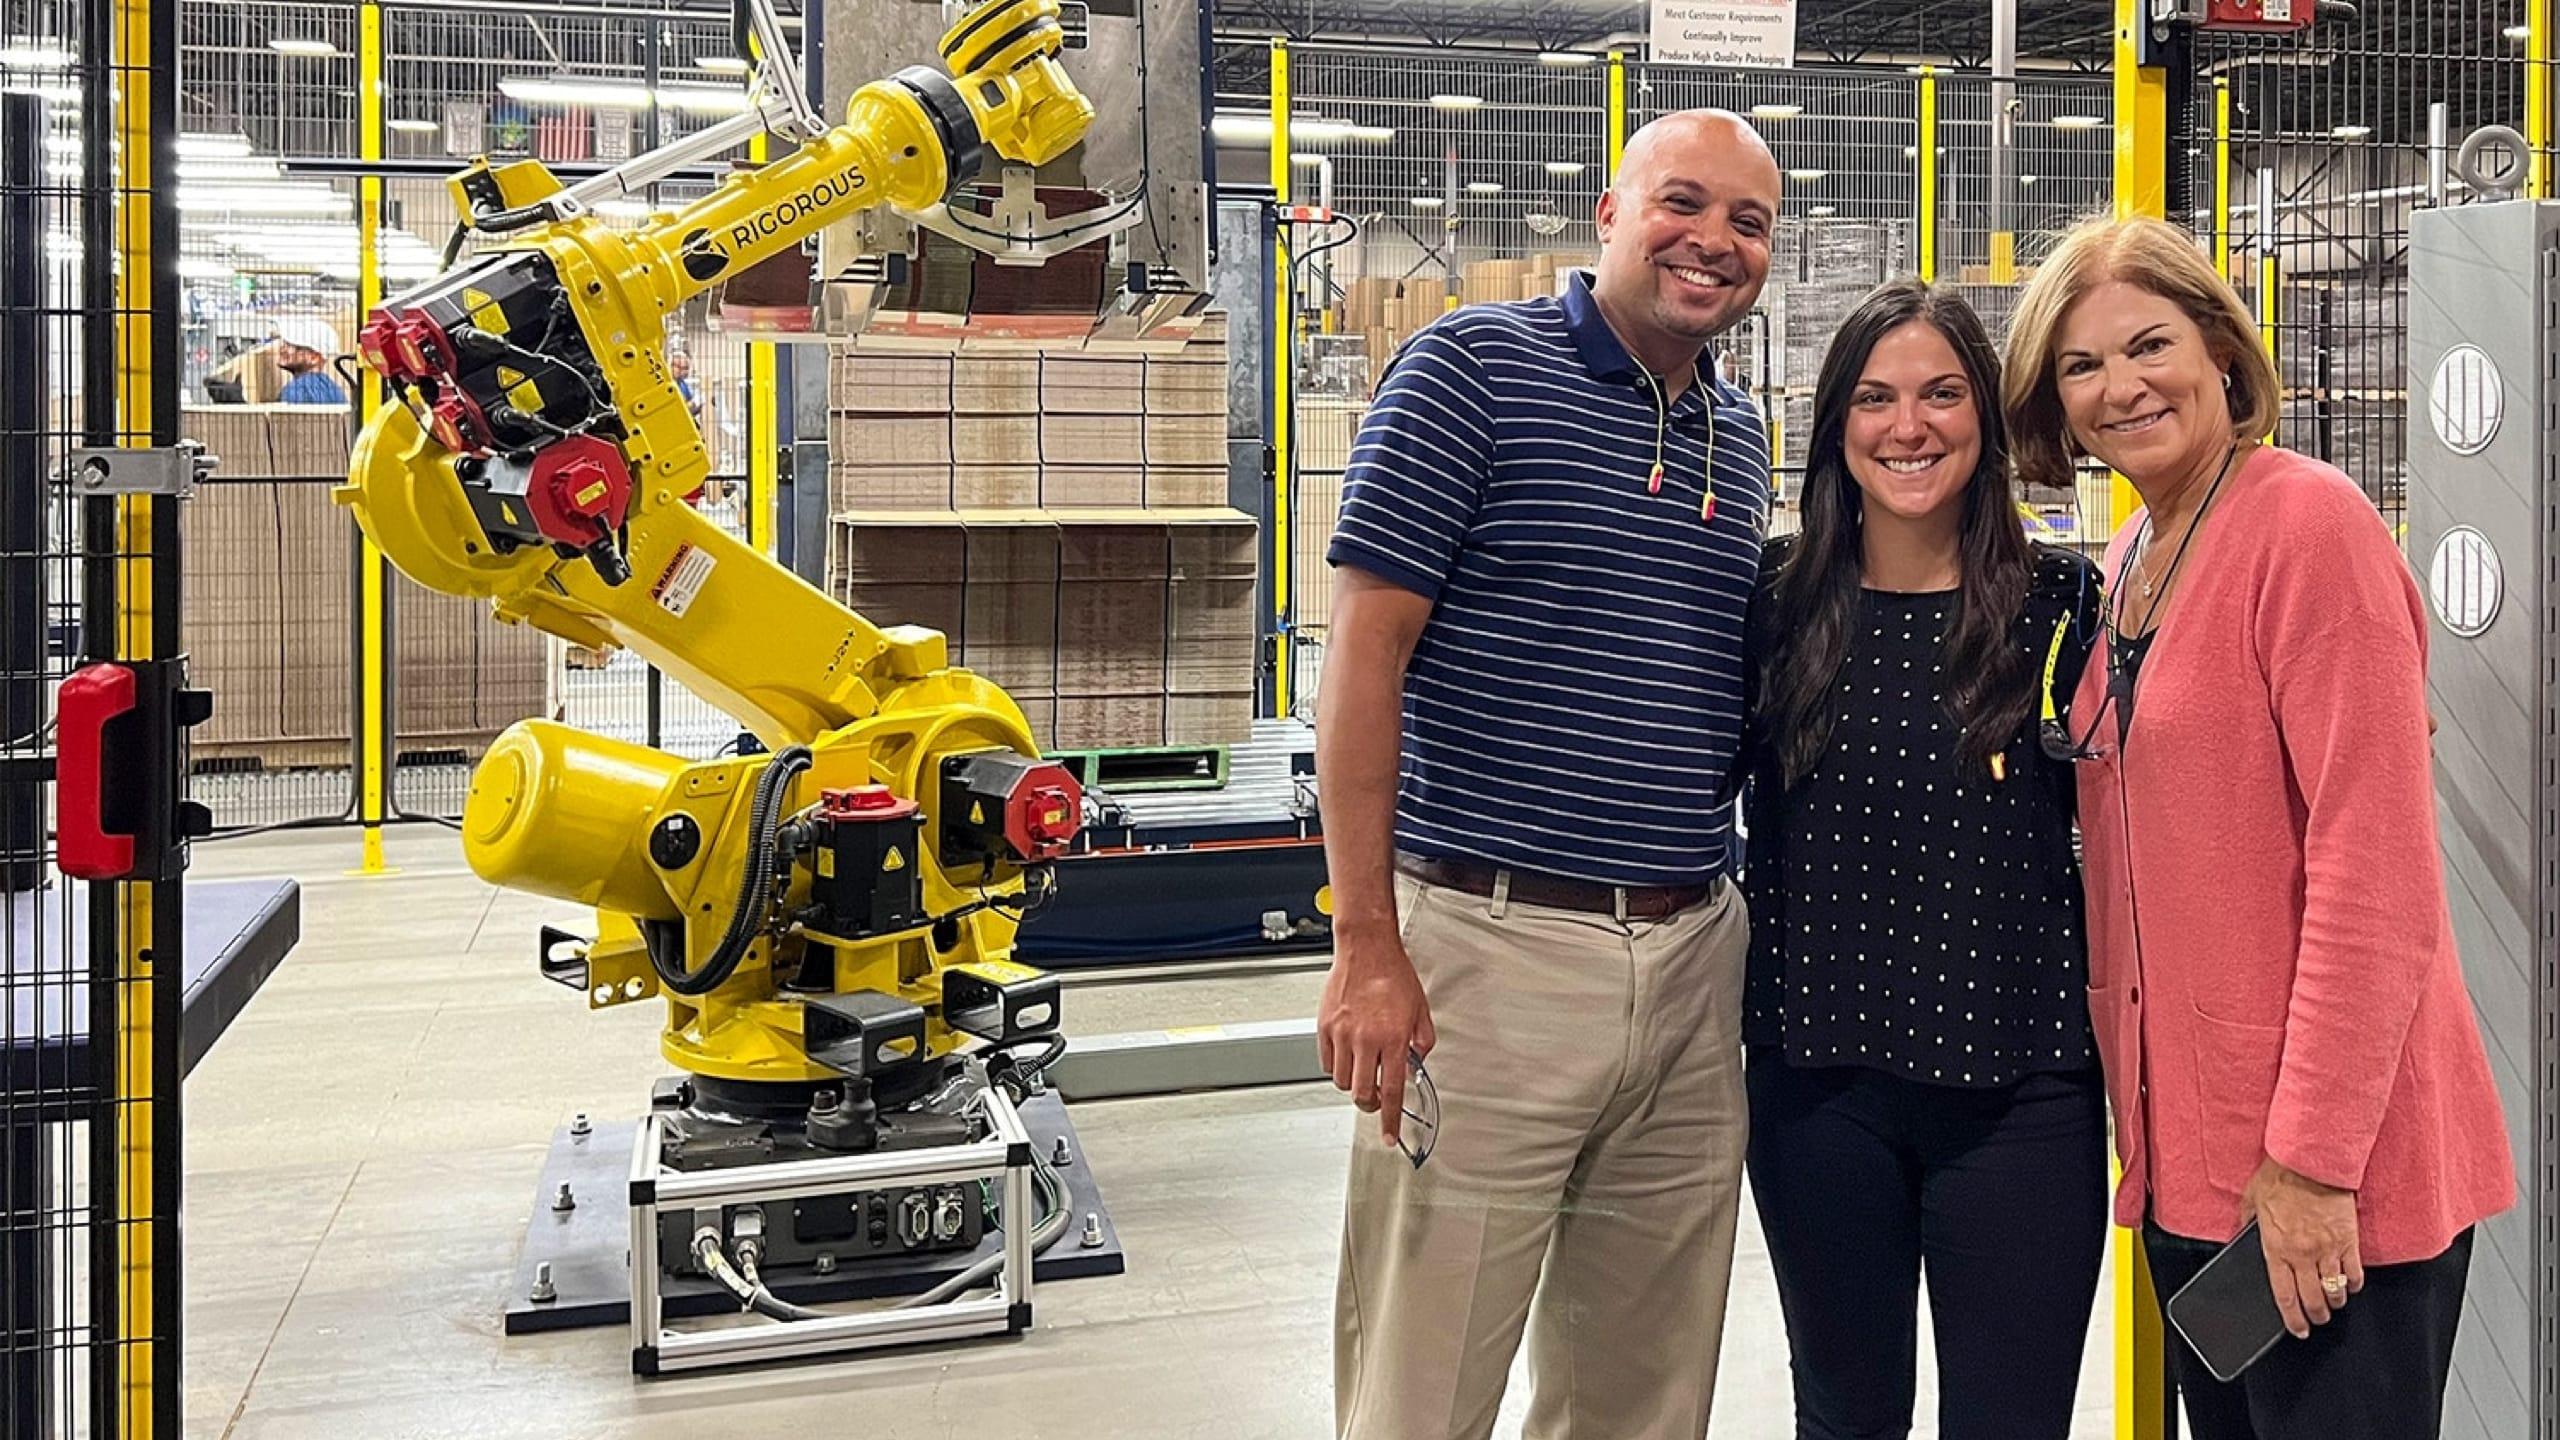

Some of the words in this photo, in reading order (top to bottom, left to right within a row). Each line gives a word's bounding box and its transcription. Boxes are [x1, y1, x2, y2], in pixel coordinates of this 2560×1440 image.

[1664, 8, 1686, 20] Meet
[1688, 9, 1726, 21] Customer
[1729, 11, 1782, 23] Requirements
[1683, 30, 1727, 43] Continually
[1730, 33, 1762, 44] Improve
[1659, 49, 1689, 60] Produce
[1692, 51, 1711, 63] High
[1713, 51, 1743, 64] Quality
[1746, 53, 1785, 66] Packaging
[731, 166, 866, 249] RIGOROUS
[656, 544, 689, 589] WARNING
